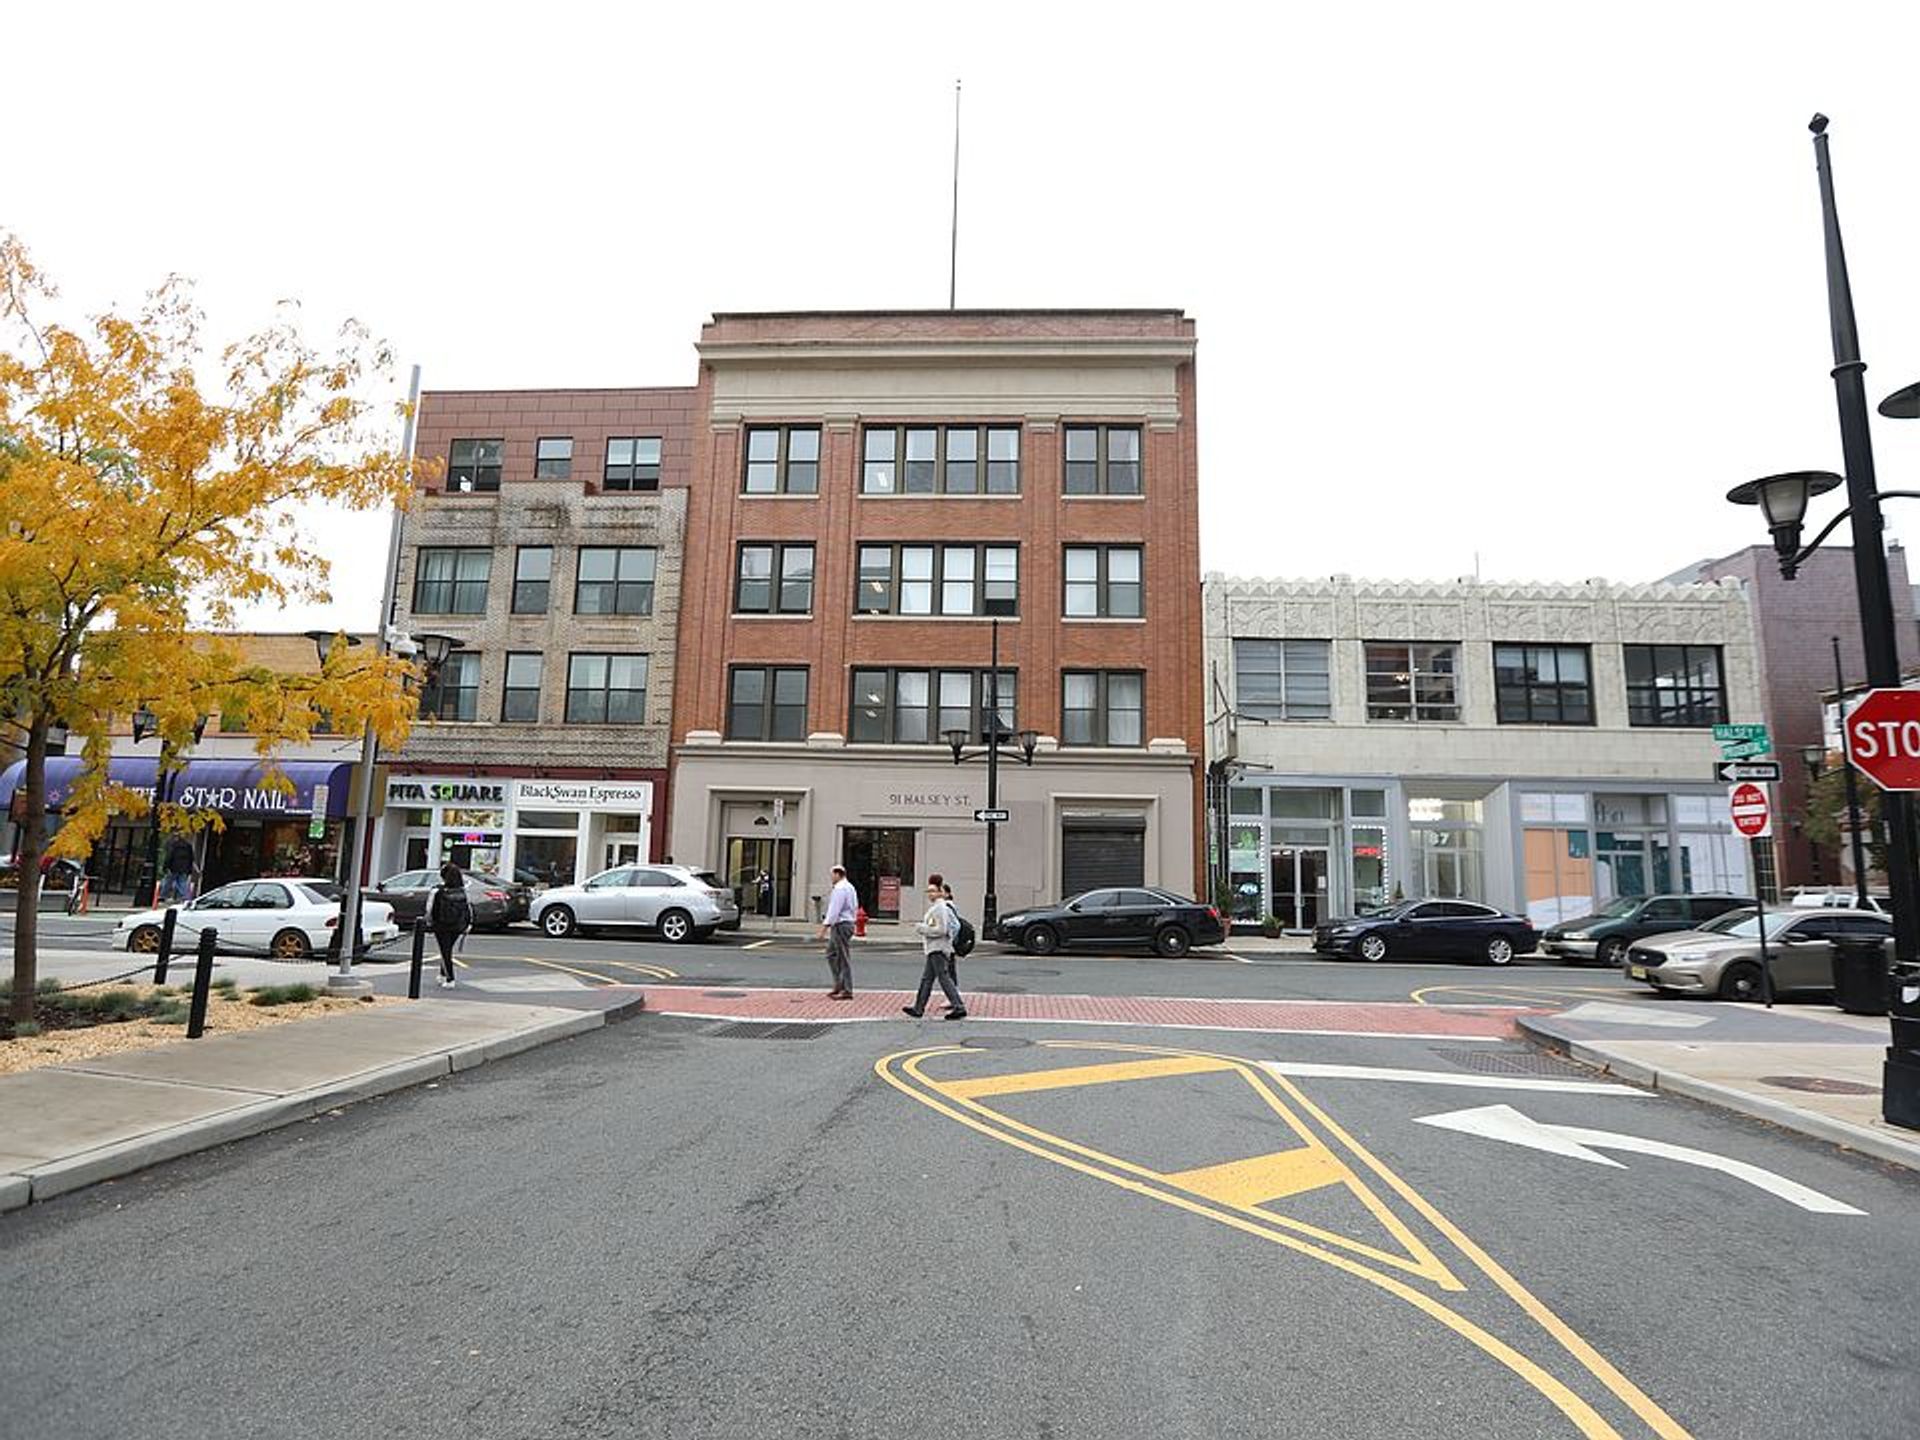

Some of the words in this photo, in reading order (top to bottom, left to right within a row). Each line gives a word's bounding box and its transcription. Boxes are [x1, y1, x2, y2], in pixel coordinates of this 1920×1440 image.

[1716, 727, 1754, 740] HALSEY
[389, 784, 426, 801] PITA
[430, 784, 503, 801] SQUARE
[590, 786, 642, 802] Espresso
[889, 794, 902, 805] 91
[904, 794, 951, 806] HALSEY
